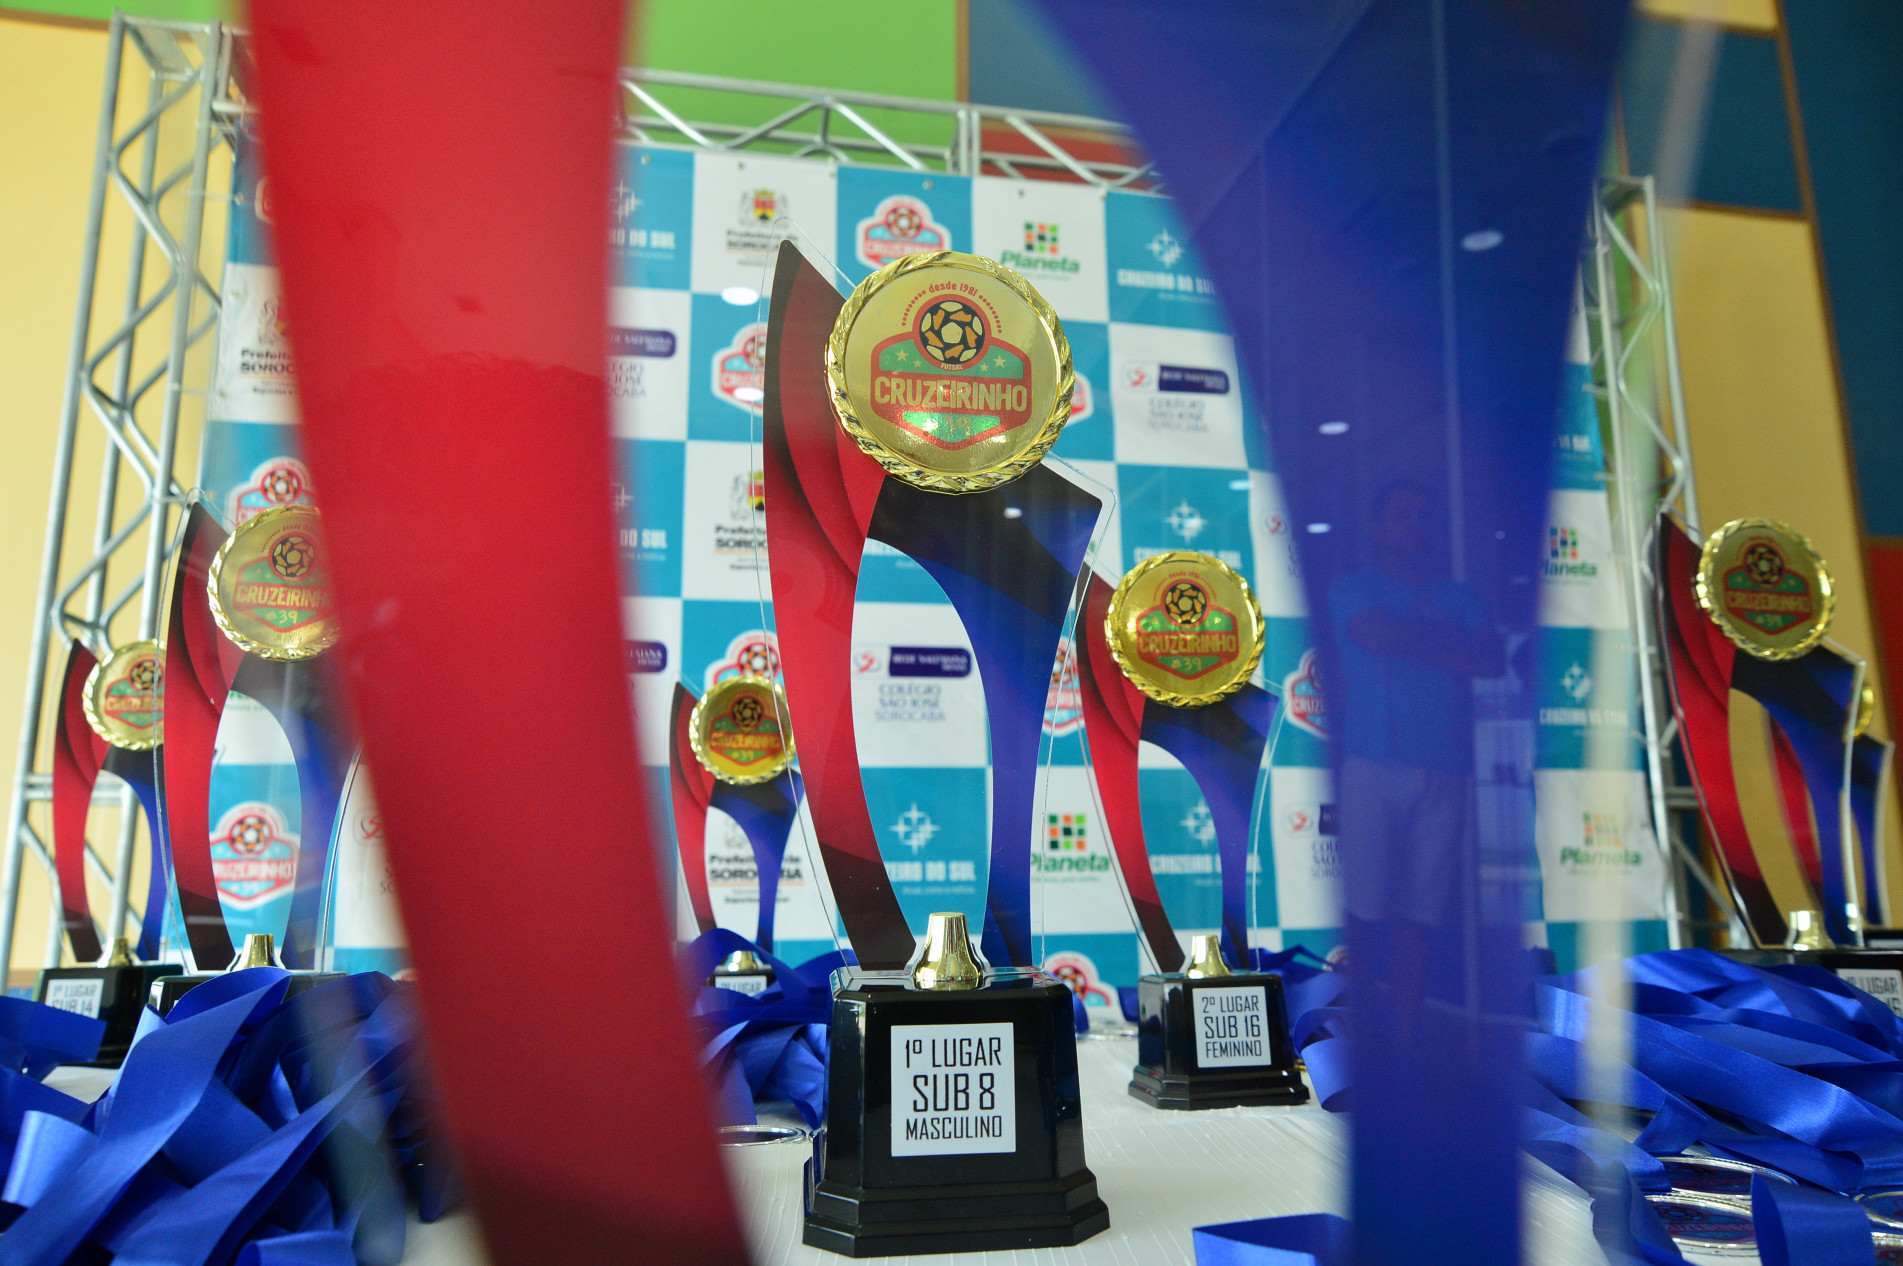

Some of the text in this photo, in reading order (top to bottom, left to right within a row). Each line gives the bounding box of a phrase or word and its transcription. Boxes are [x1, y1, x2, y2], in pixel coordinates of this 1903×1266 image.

[1001, 250, 1080, 273] Planeta
[928, 281, 978, 297] desde 1981
[874, 376, 1028, 412] CRUZEIRINHO
[641, 528, 668, 549] SUL
[1138, 633, 1237, 652] CRUZEIRINHO
[926, 861, 946, 881] DO
[949, 861, 976, 881] SUL
[1219, 995, 1260, 1013] LUGAR
[1204, 1014, 1261, 1039] SUB 16
[905, 1037, 1002, 1069] 1º LUGAR
[1205, 1040, 1262, 1059] FEMININO
[913, 1072, 995, 1112] SUB 8
[906, 1115, 1002, 1141] MASCULINO
